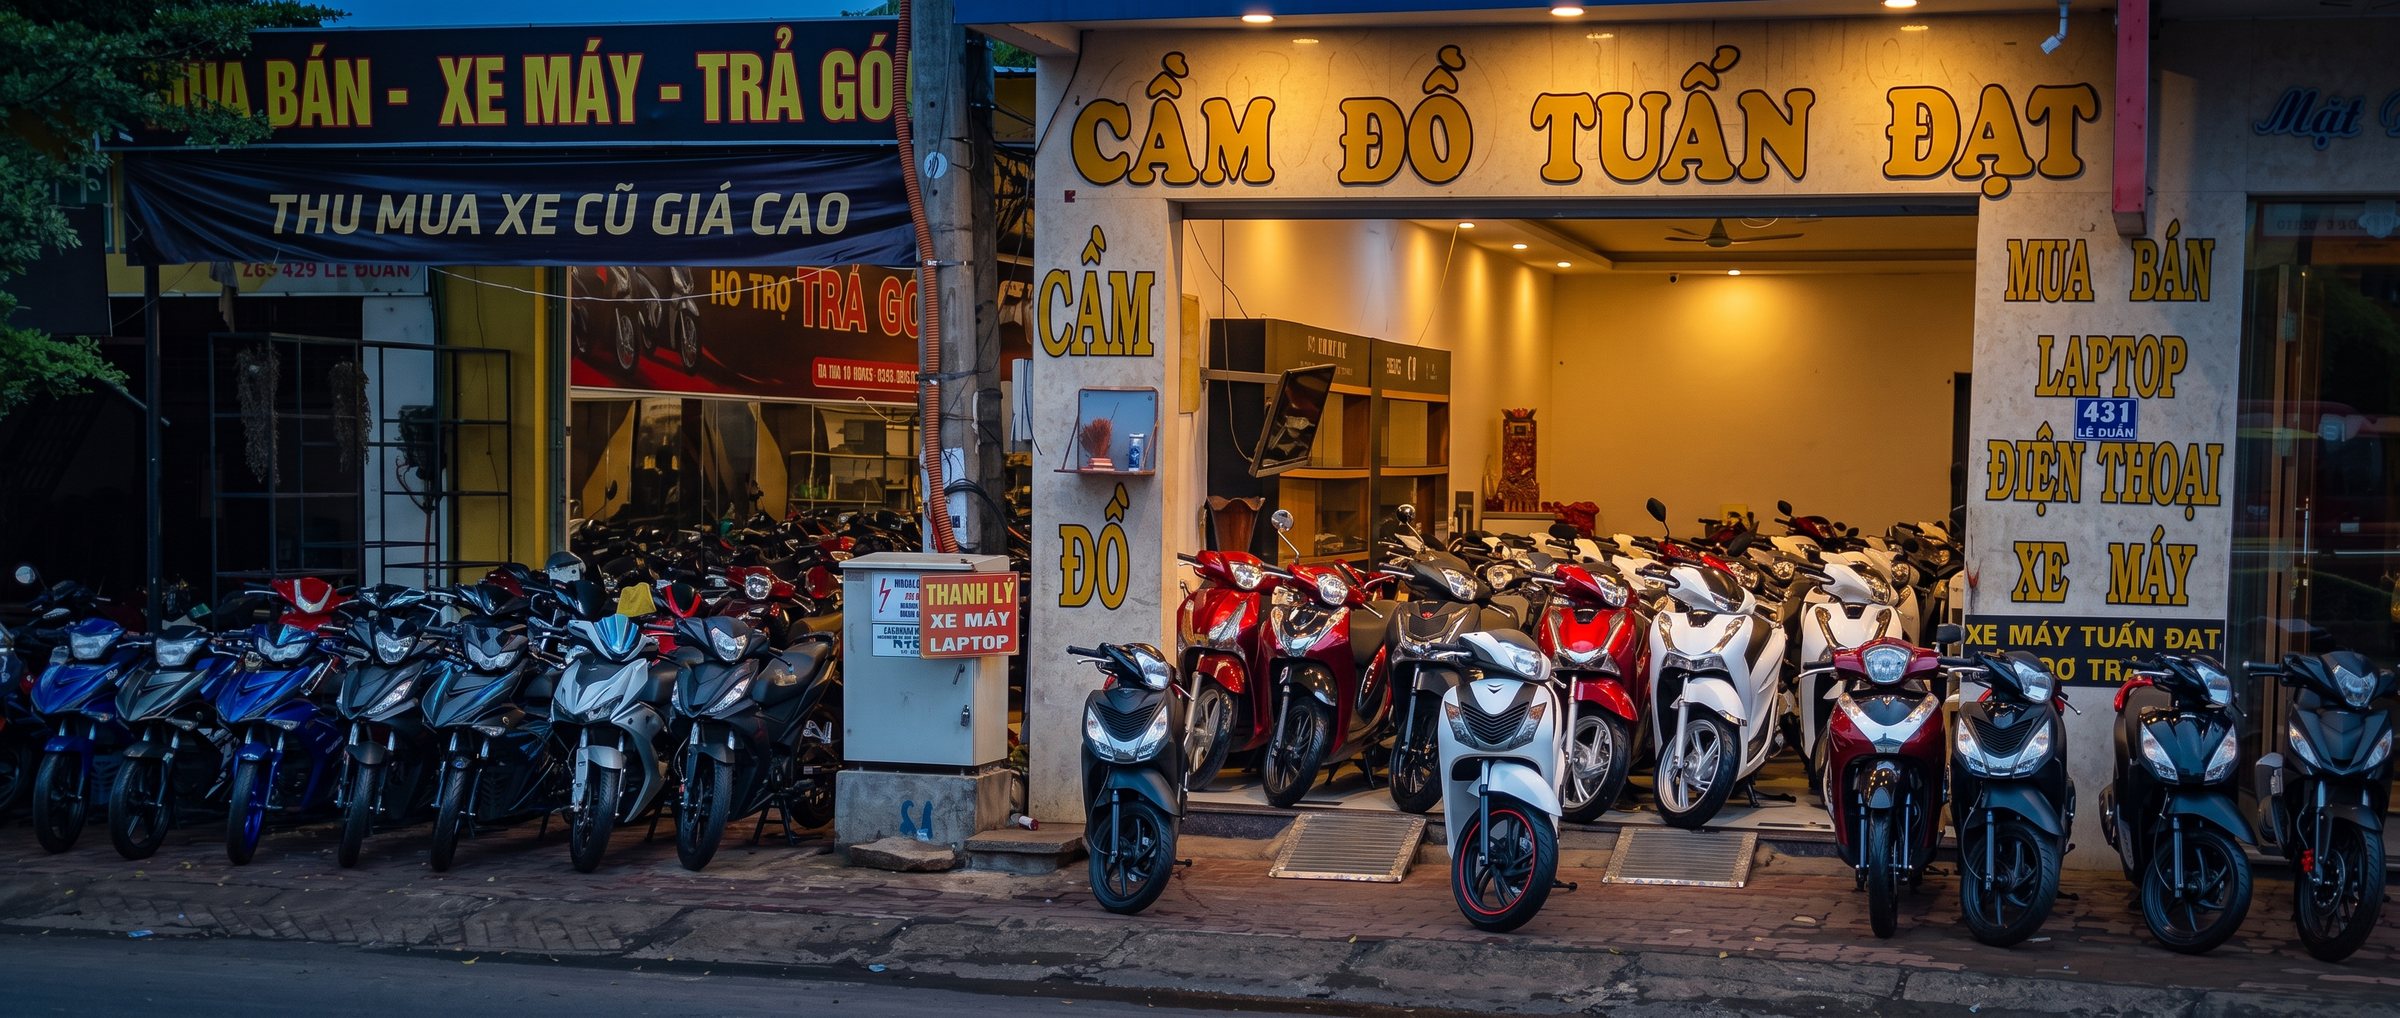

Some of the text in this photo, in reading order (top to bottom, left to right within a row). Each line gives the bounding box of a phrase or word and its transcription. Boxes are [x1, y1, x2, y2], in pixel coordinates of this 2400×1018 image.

[264, 43, 373, 128] BÁN
[437, 55, 507, 126] XE
[522, 37, 645, 126] MÁY
[696, 26, 805, 123] TRẢ
[820, 32, 912, 123] GÓ
[1071, 44, 2101, 199] CẦM ĐỒ TUẤN ĐẠT
[269, 180, 850, 235] THU MUA XE CŨ GIÁ CAO
[1037, 224, 1155, 358] CẦM
[2004, 218, 2215, 302] MUA BÁN
[2035, 335, 2187, 398] LAPTOP
[2083, 401, 2129, 423] 431
[1985, 420, 2224, 521] ĐIỆN THOẠI
[1059, 482, 1130, 610] ĐỒ
[2011, 524, 2198, 607] XE MÁY
[926, 577, 1014, 606] THANH LÝ
[930, 608, 1010, 629] XE MÁY
[930, 635, 1009, 652] LAPTOP
[1965, 620, 2221, 653] XE MÁY TUẤN ĐẠT
